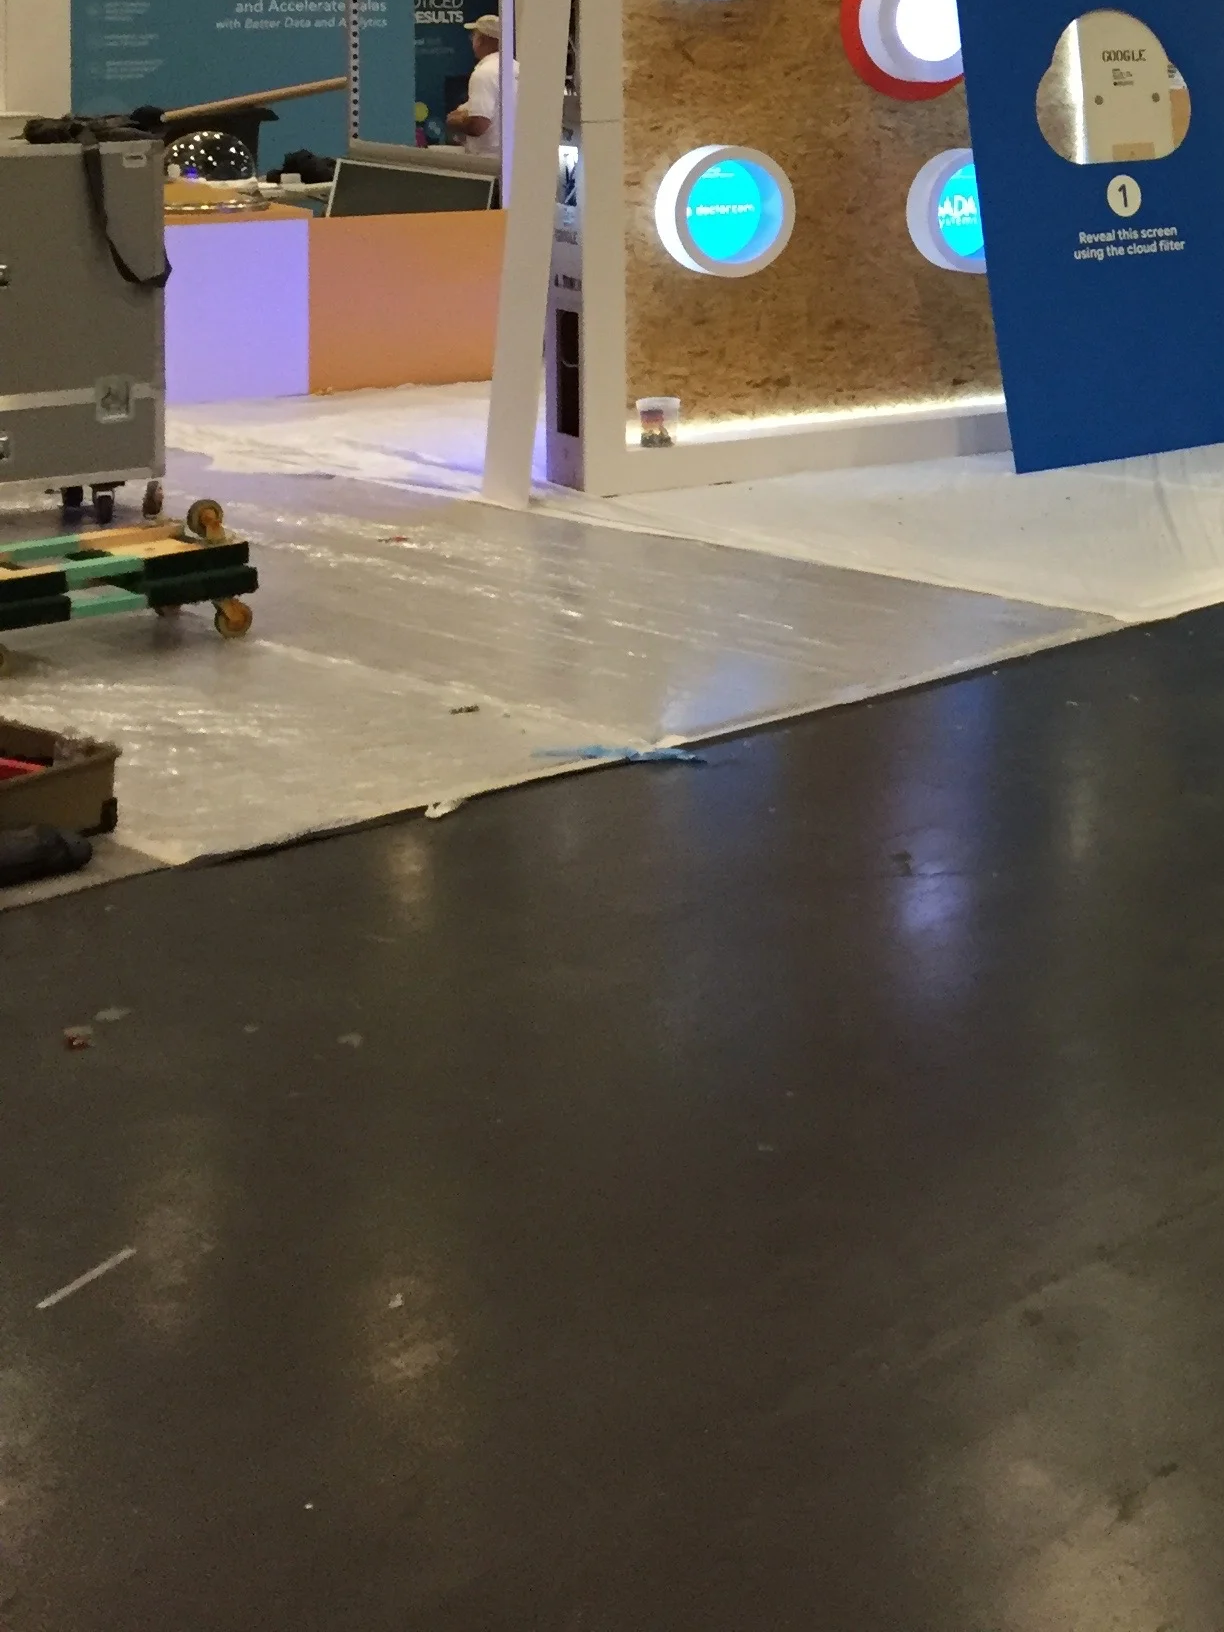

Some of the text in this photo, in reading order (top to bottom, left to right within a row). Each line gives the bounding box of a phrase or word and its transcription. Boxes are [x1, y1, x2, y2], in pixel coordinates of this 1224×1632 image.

[235, 0, 264, 13] and
[216, 19, 241, 30] with
[284, 17, 312, 29] Data
[314, 17, 336, 29] and
[1102, 49, 1147, 63] GOOGLE
[1117, 183, 1128, 208] 1
[1078, 227, 1178, 245] Reveal this screen
[1073, 239, 1186, 261] using the cloud filter
